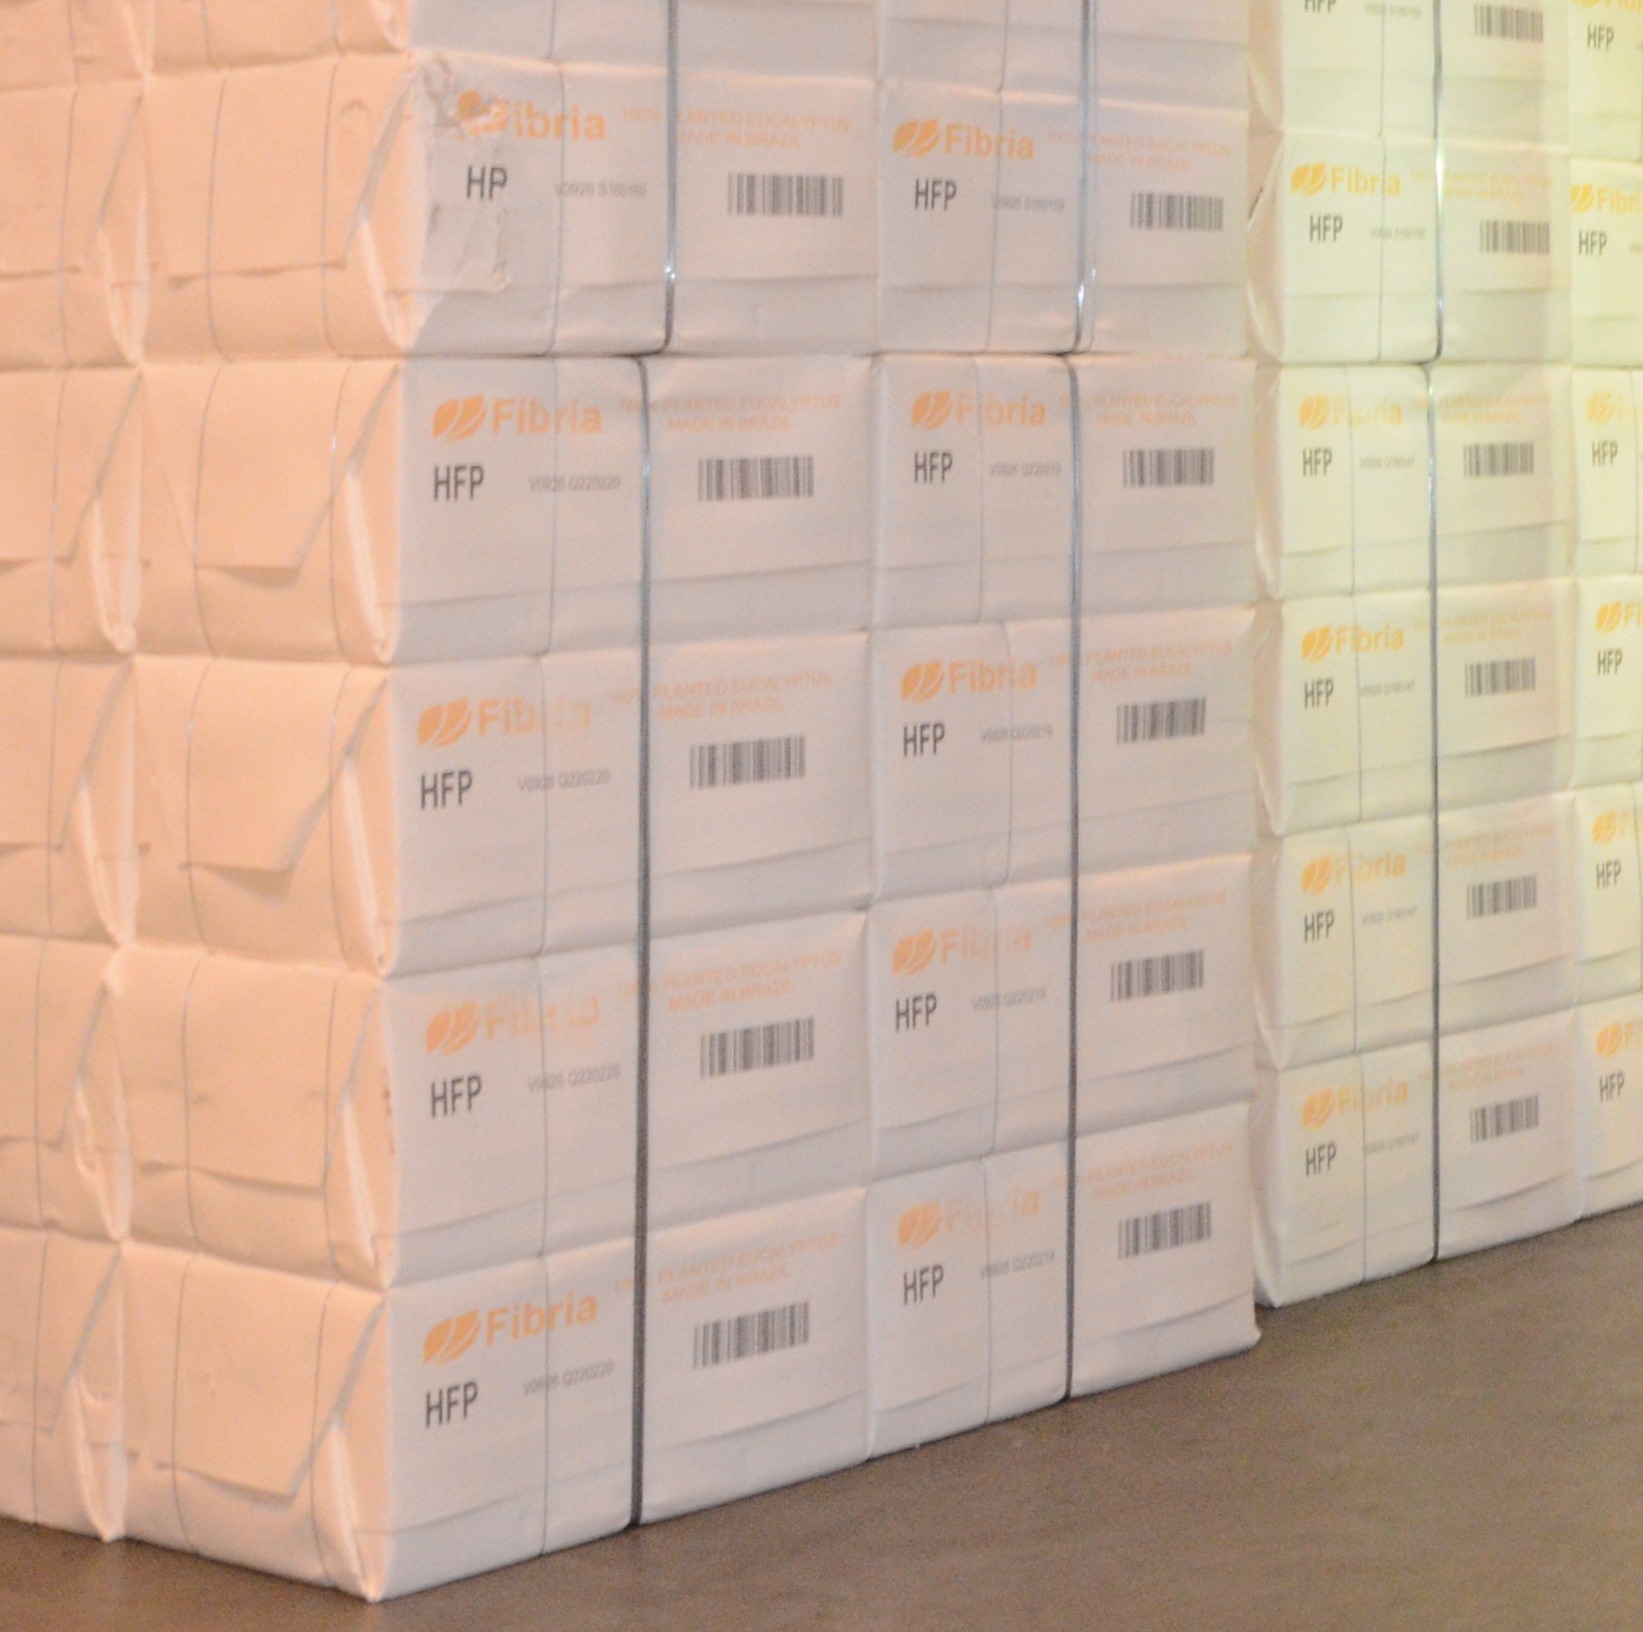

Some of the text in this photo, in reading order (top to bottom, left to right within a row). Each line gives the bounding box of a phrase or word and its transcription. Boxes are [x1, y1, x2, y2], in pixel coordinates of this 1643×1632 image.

[1587, 25, 1614, 52] HFP
[503, 100, 605, 141] ibria
[668, 109, 741, 126] LANTED
[944, 125, 1035, 160] Fibria
[914, 180, 956, 212] HFP
[1327, 165, 1401, 196] Fibria
[1309, 214, 1343, 243] HFP
[1578, 229, 1607, 256] HFP
[491, 396, 601, 437] Fibria
[913, 451, 952, 484] HFP
[1301, 448, 1332, 477] HFP
[1591, 440, 1618, 467] HFP
[434, 464, 484, 502] HFP
[1331, 625, 1403, 657] Fibria
[948, 659, 1037, 691] Fibria
[1597, 646, 1623, 675] HFP
[1303, 679, 1334, 710] HFP
[903, 723, 945, 756] HFP
[420, 771, 473, 809] HFP
[1596, 859, 1621, 888] HFP
[1303, 910, 1334, 941] HFP
[895, 995, 938, 1032] HFP
[430, 1074, 482, 1119] HFP
[1599, 1073, 1625, 1102] HFP
[1304, 1143, 1336, 1176] HFP
[902, 1266, 945, 1305] HFP
[484, 1291, 598, 1344] Fibria
[425, 1381, 478, 1430] HFP
